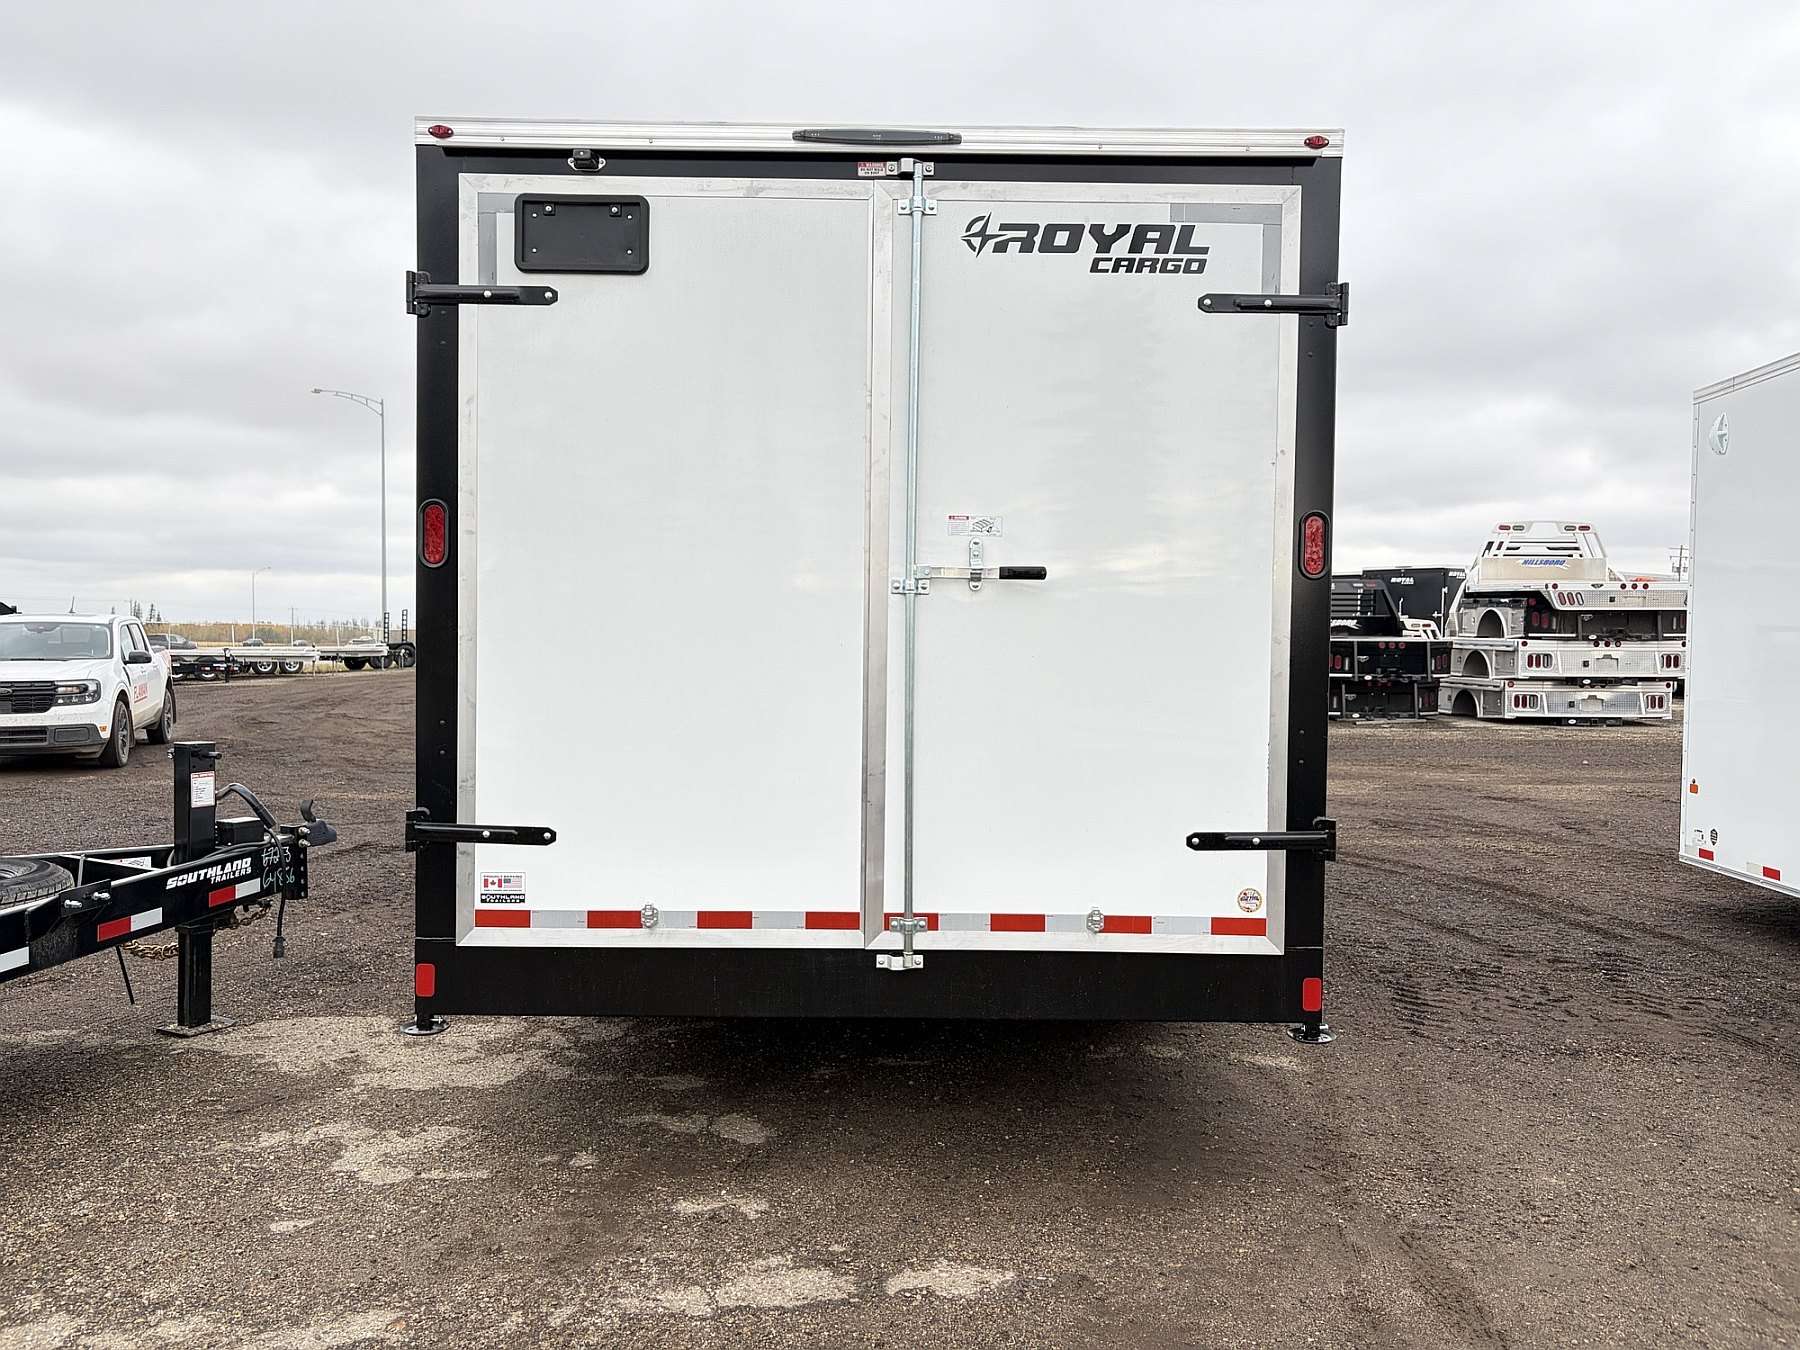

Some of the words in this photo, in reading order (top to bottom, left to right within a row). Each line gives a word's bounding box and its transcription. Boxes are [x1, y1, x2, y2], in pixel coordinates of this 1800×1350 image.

[992, 222, 1211, 255] ROYAL
[1089, 257, 1208, 274] CARGO
[1521, 558, 1567, 567] HILLSBORO
[165, 857, 252, 890] SOUTHLAND
[210, 866, 252, 884] TRAILERS
